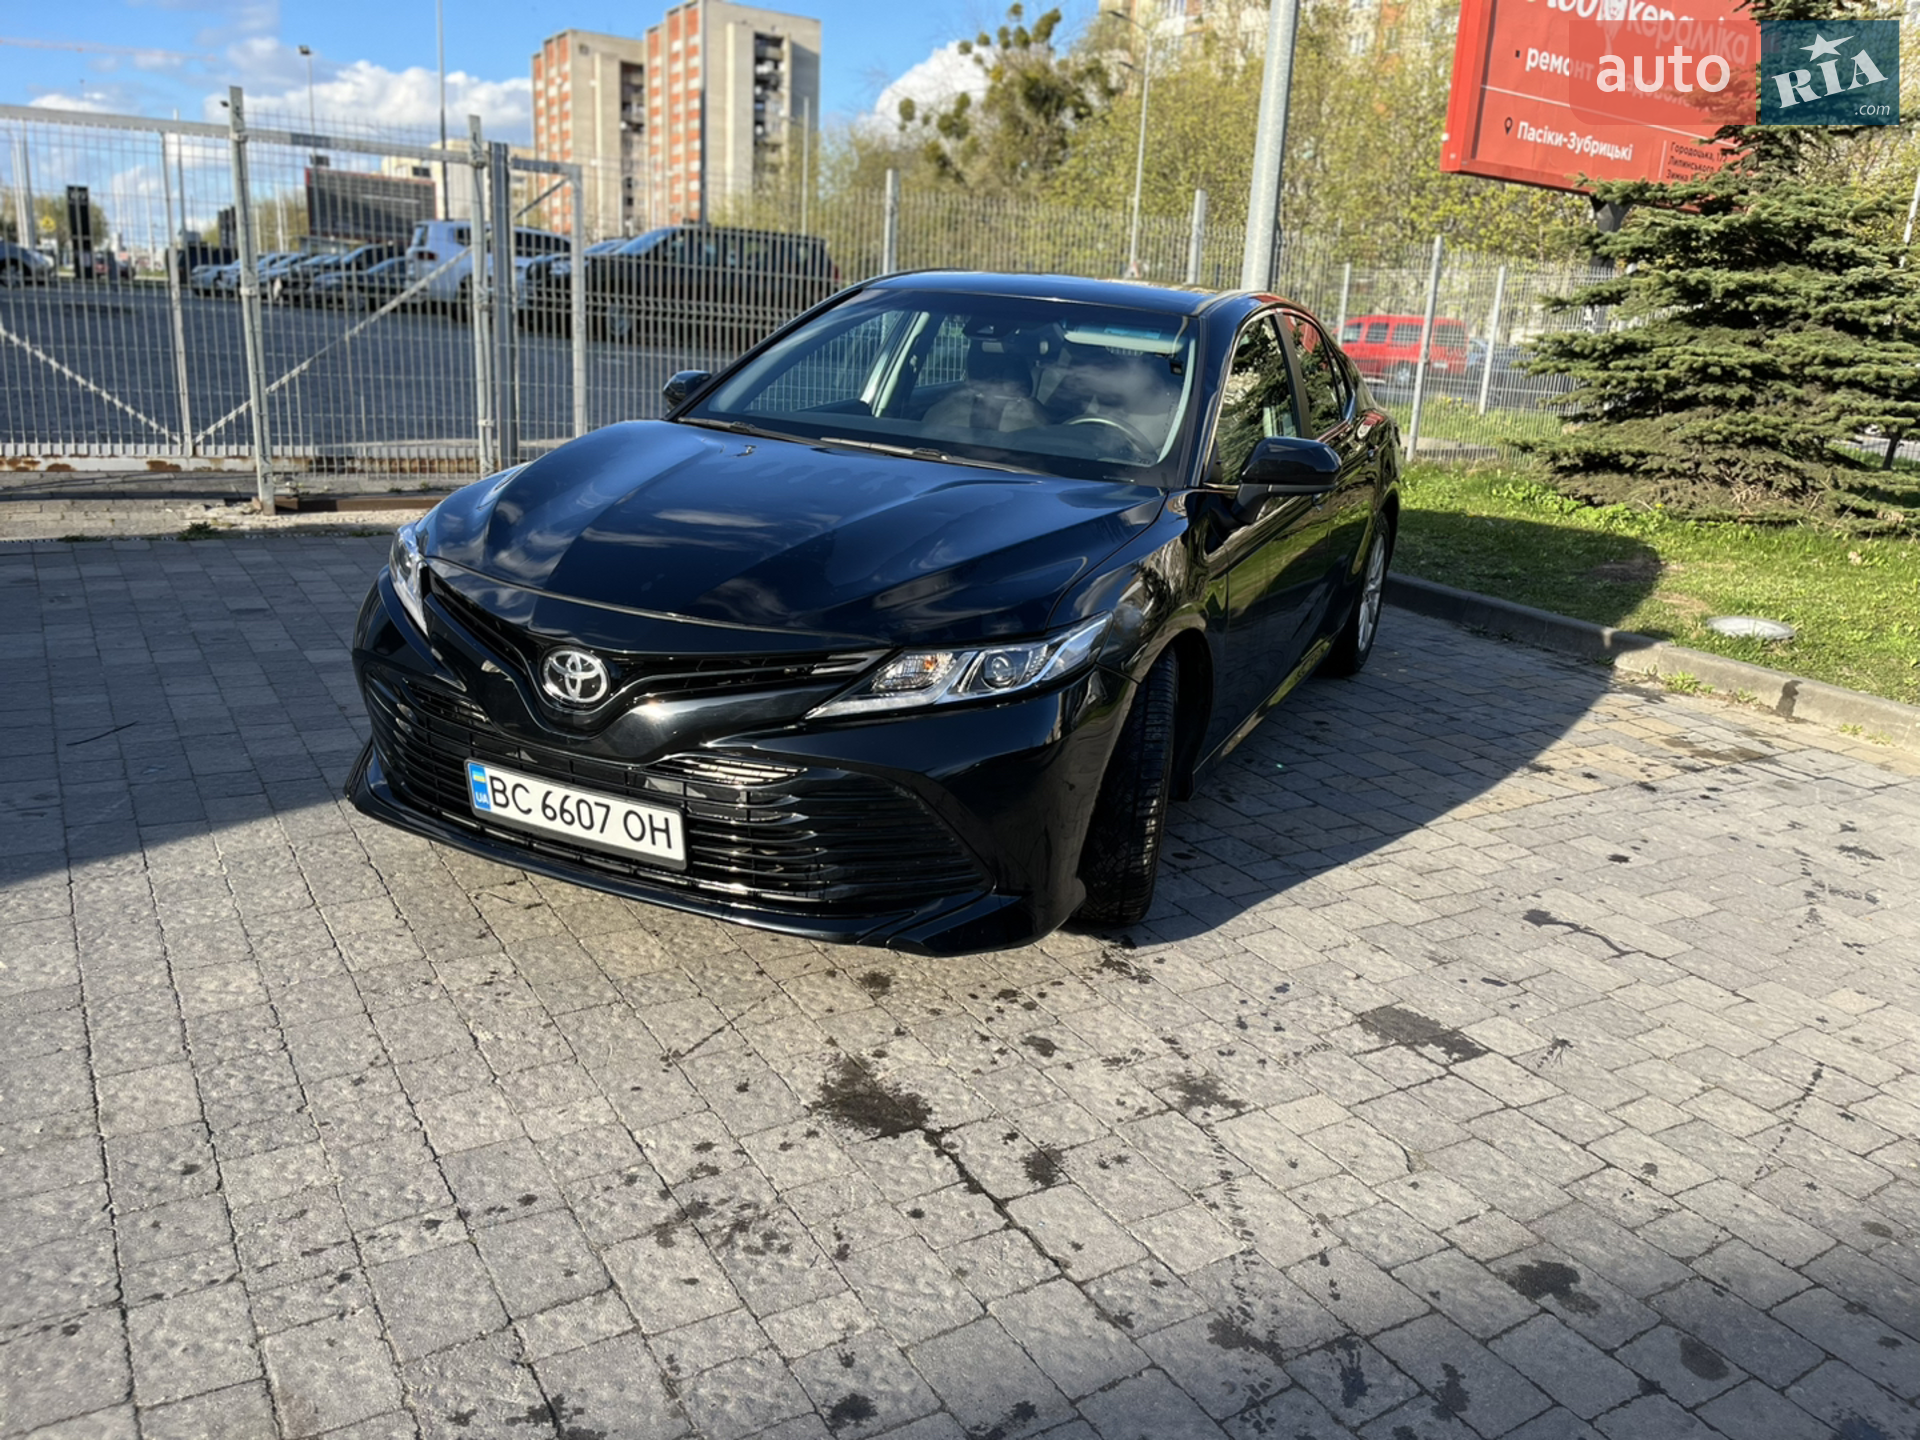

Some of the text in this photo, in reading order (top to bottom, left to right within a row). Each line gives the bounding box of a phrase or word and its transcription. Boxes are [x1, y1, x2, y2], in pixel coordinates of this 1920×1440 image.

[1525, 47, 1595, 82] ремонт
[1517, 121, 1633, 161] Пасіки-Зубрицькі
[475, 791, 489, 805] UA
[489, 775, 672, 849] BC 6607 OH
